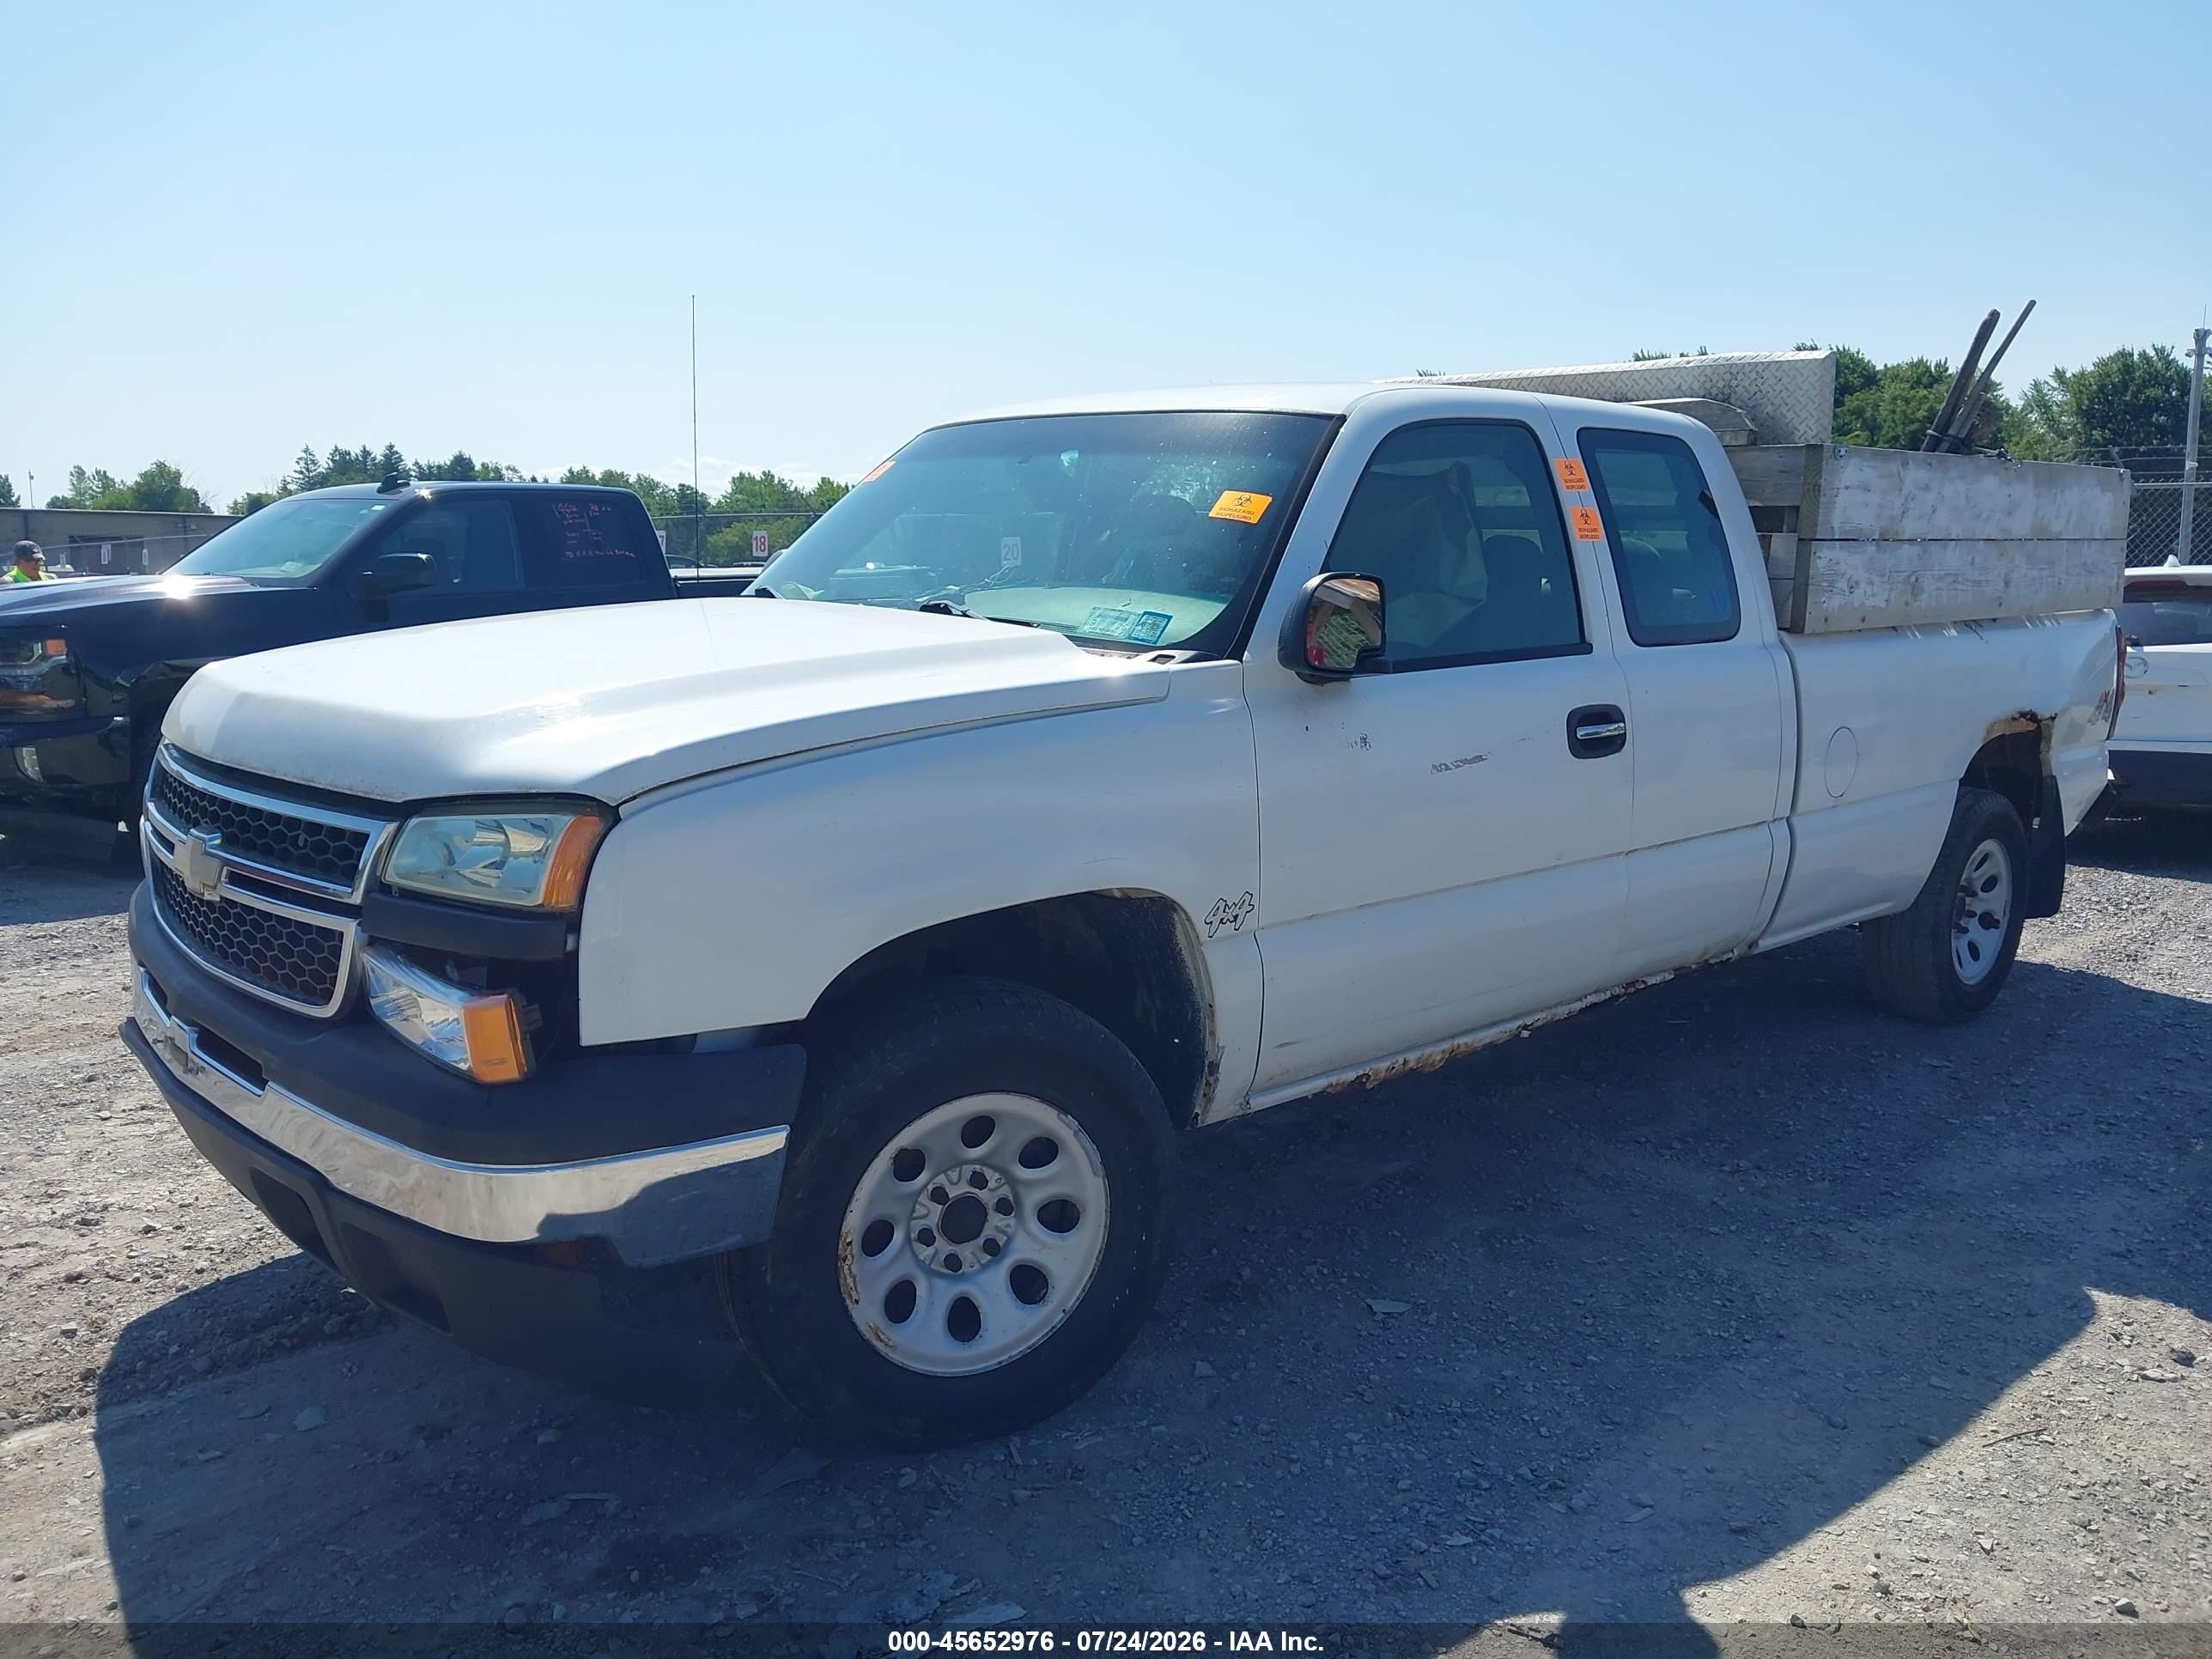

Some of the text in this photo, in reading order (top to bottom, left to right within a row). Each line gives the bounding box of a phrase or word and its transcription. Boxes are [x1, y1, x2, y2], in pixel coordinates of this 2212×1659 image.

[1215, 512, 1252, 521] BIOPELIGRO
[1218, 507, 1255, 516] BIOHAZARD
[753, 535, 767, 553] 18
[1002, 543, 1020, 562] 20
